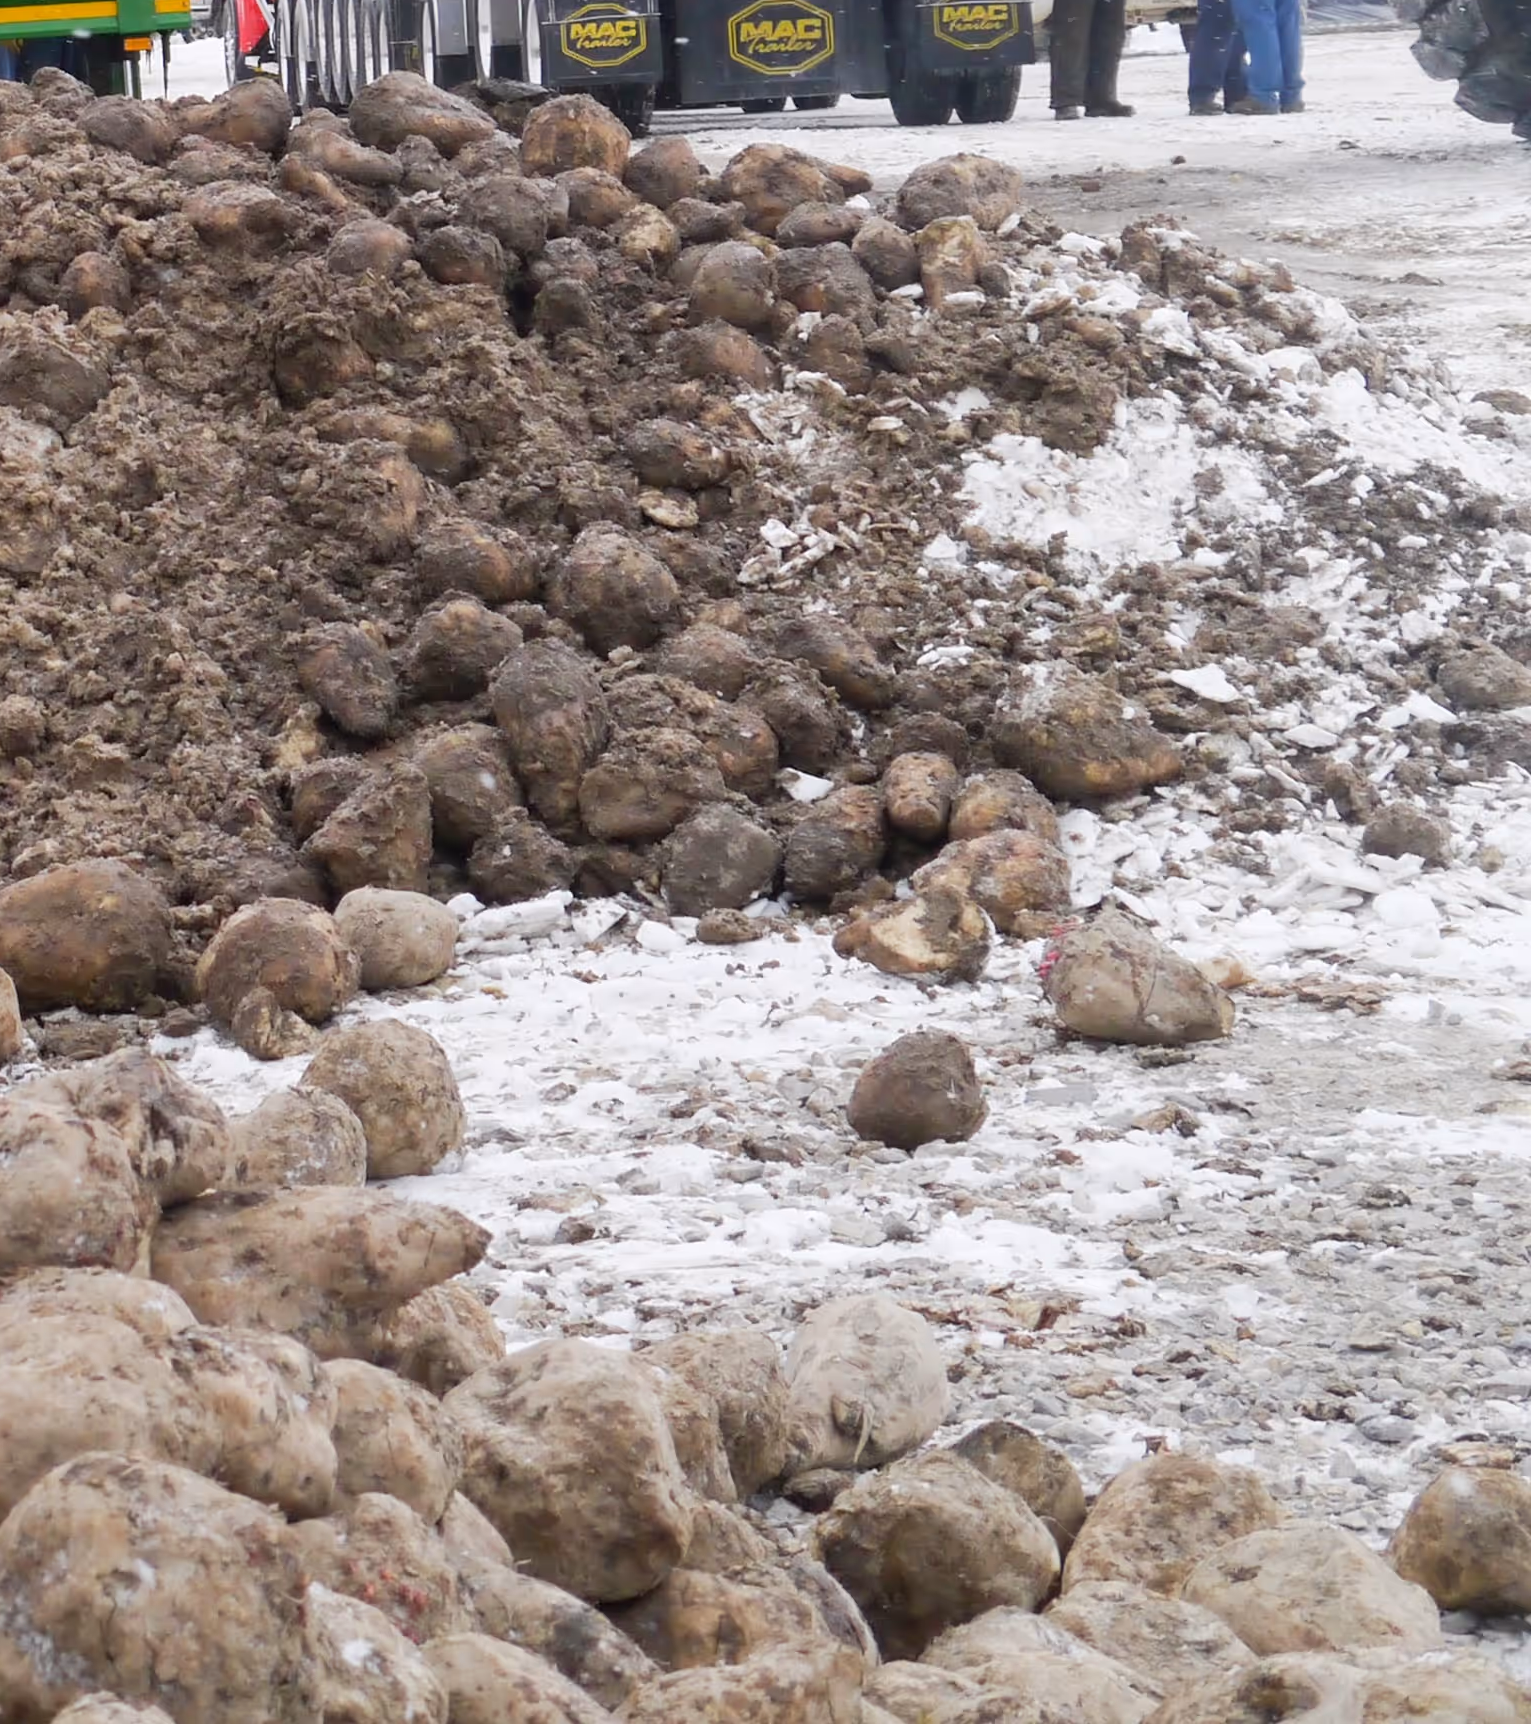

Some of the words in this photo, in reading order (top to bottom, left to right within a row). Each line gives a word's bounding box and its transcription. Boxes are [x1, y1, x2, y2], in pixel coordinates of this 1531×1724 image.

[942, 4, 1009, 22] MAC
[570, 20, 637, 39] MAC
[740, 18, 822, 42] MAC
[576, 35, 632, 49] Trailer
[746, 36, 816, 54] Trailer
